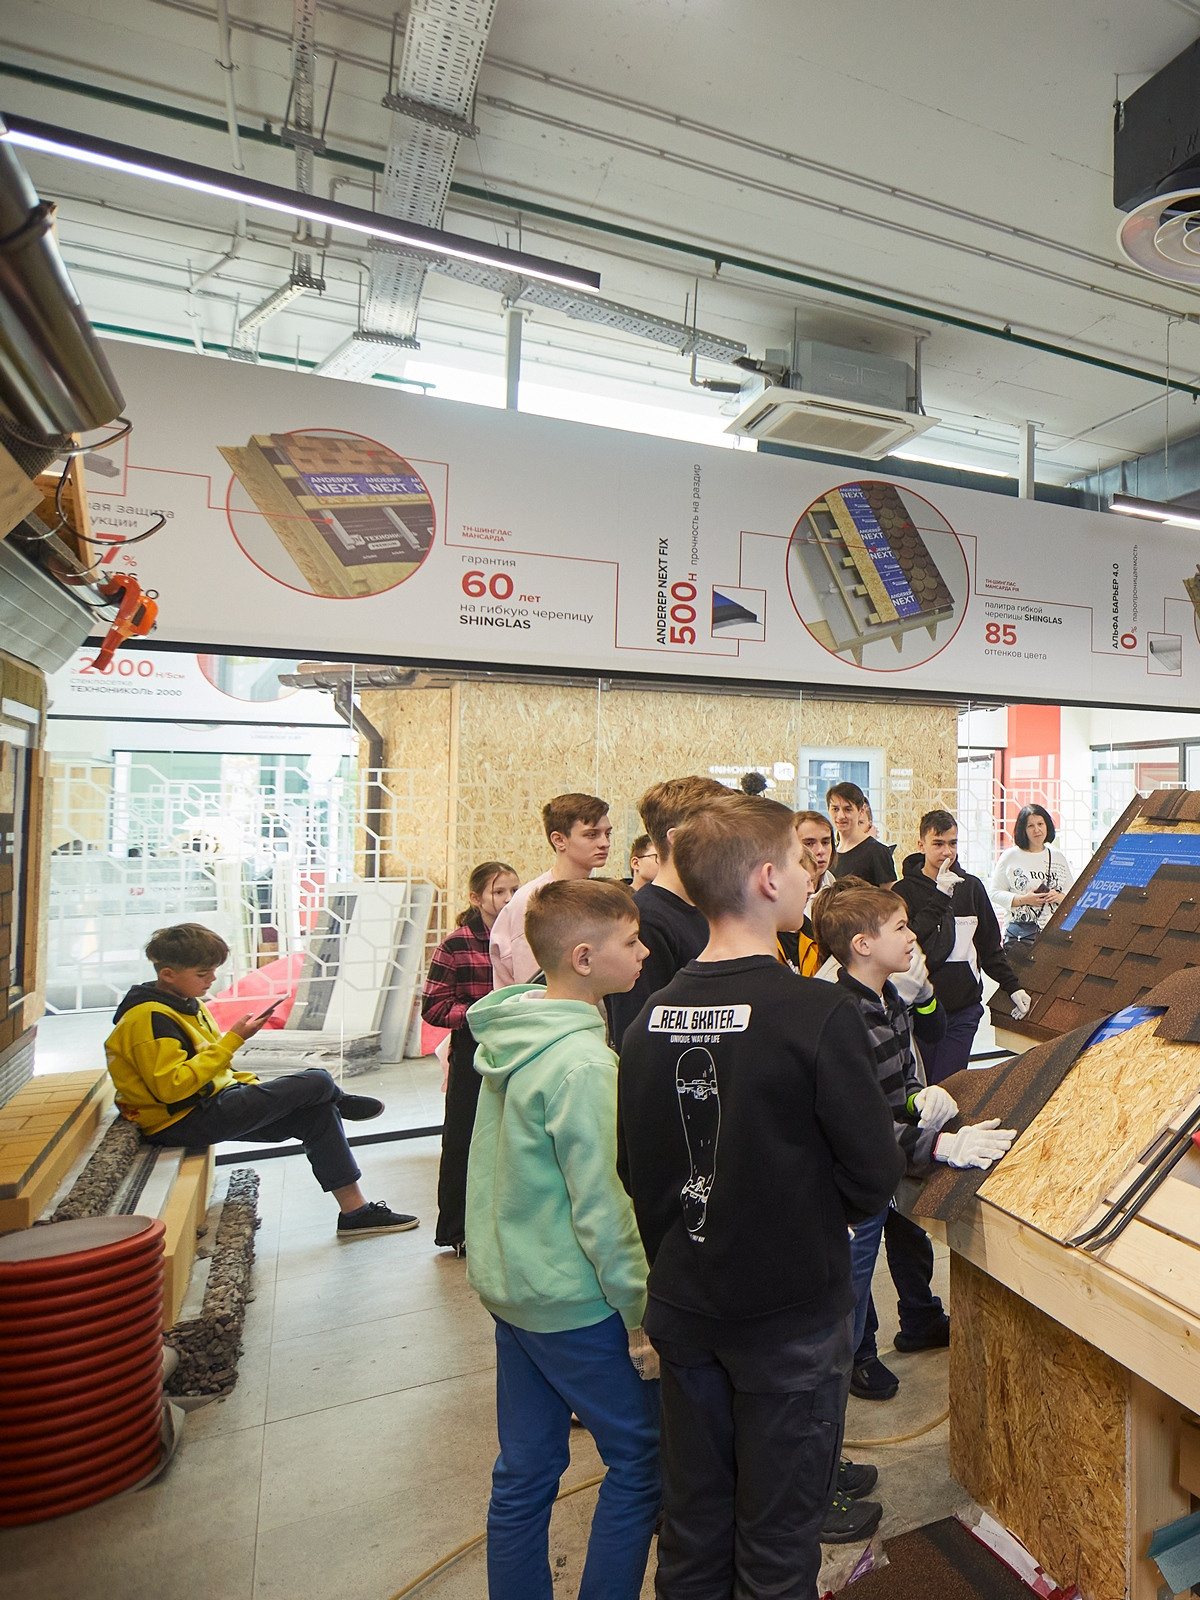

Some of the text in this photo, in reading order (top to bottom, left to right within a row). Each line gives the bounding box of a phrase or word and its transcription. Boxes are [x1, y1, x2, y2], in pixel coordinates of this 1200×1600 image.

[314, 483, 360, 494] NEXT
[368, 483, 408, 493] NEXT
[691, 464, 702, 566] прочность на раздир
[462, 532, 505, 542] МАНСАРДА
[861, 532, 884, 540] NEXT
[461, 555, 516, 567] гарантия
[870, 551, 893, 559] NEXT
[1112, 563, 1120, 577] 4.0
[462, 570, 541, 603] 60 лет
[657, 537, 669, 645] ANDEREP NEXT FIX
[892, 595, 916, 607] NEXT
[985, 601, 1043, 613] палитра гибкой
[460, 604, 594, 624] на гибкую черепицу
[670, 581, 698, 645] 500
[985, 611, 1063, 625] черепицы SHINGLAS
[459, 614, 531, 629] SHINGLAS
[985, 622, 1017, 646] 85
[984, 648, 1047, 660] оттенков цвета
[70, 685, 154, 695] ТЕХНОНИКОЛЬ
[1088, 880, 1126, 891] NDEREP
[670, 1035, 721, 1043] UNIQUE WAY OF LIFE
